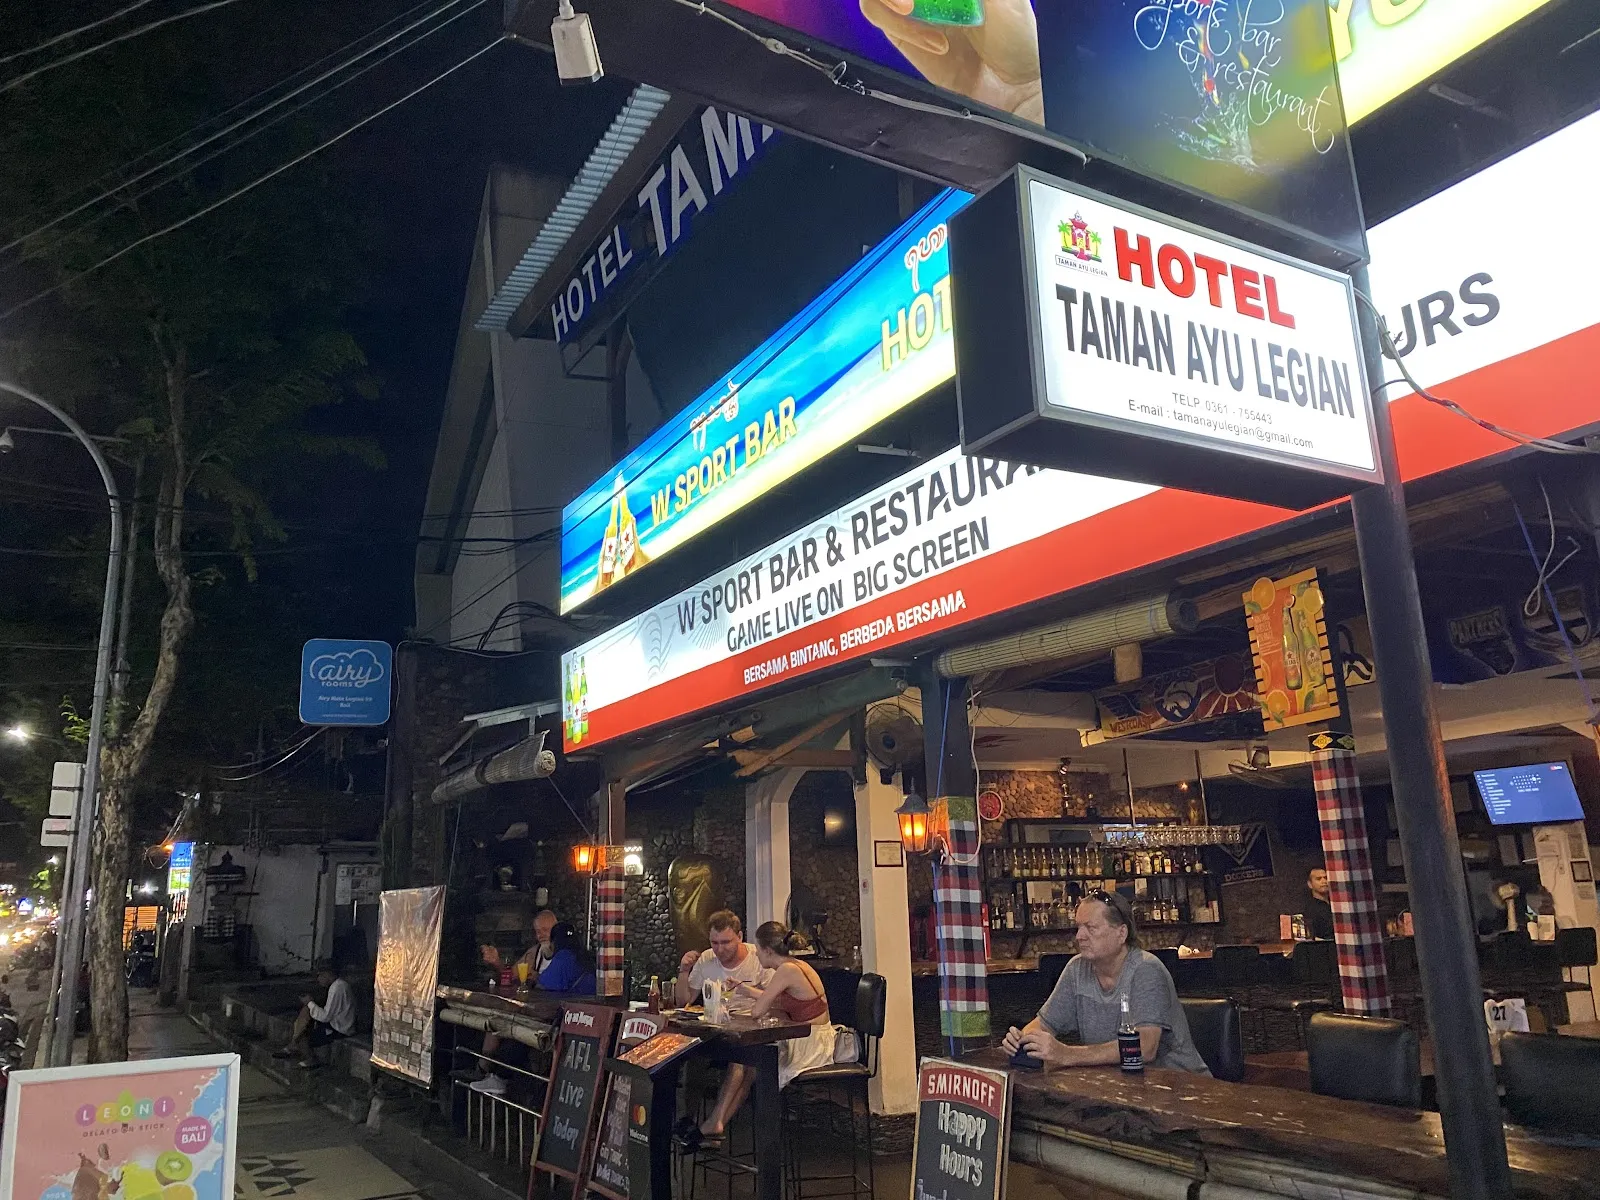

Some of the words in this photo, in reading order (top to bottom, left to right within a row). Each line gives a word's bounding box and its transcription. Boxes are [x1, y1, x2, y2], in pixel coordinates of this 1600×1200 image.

[1214, 55, 1335, 154] restaurant
[551, 225, 633, 343] HOTEL
[637, 106, 774, 257] TAM
[1057, 257, 1077, 268] TAMAN
[1078, 262, 1089, 272] AYU
[1113, 226, 1296, 329] HOTEL
[1055, 283, 1176, 377] TAMAN
[1187, 320, 1245, 392] AYU
[1253, 337, 1356, 419] LEGIAN
[1128, 399, 1163, 417] E-mail
[1173, 410, 1314, 449] tamanayulegian@gmail.com
[1205, 400, 1229, 415] 0361
[1239, 408, 1273, 425] 755443
[651, 482, 671, 528] W
[674, 433, 740, 513] SPORT
[744, 395, 798, 468] BAR
[677, 597, 696, 635] W
[701, 565, 764, 625] SPORT
[770, 537, 818, 594] BAR
[826, 525, 845, 567] &
[727, 611, 773, 653] GAME
[775, 592, 813, 638] LIVE
[816, 578, 845, 616] ON
[853, 560, 888, 602] BIG
[894, 515, 990, 585] SCREEN
[743, 655, 789, 686] BERSAMA
[790, 638, 839, 668] BINTANG,
[840, 616, 896, 651] BERBEDA
[896, 590, 967, 630] BERSAMA
[317, 658, 372, 688] airy
[1492, 1005, 1507, 1021] 27
[564, 1040, 591, 1072] AFL
[559, 1080, 584, 1108] Live
[927, 1073, 996, 1107] SMIRNOFF
[82, 1128, 117, 1138] GELATO
[139, 1123, 165, 1131] STICK
[553, 1115, 579, 1150] Today
[938, 1102, 987, 1151] Happy
[939, 1143, 983, 1187] Hours
